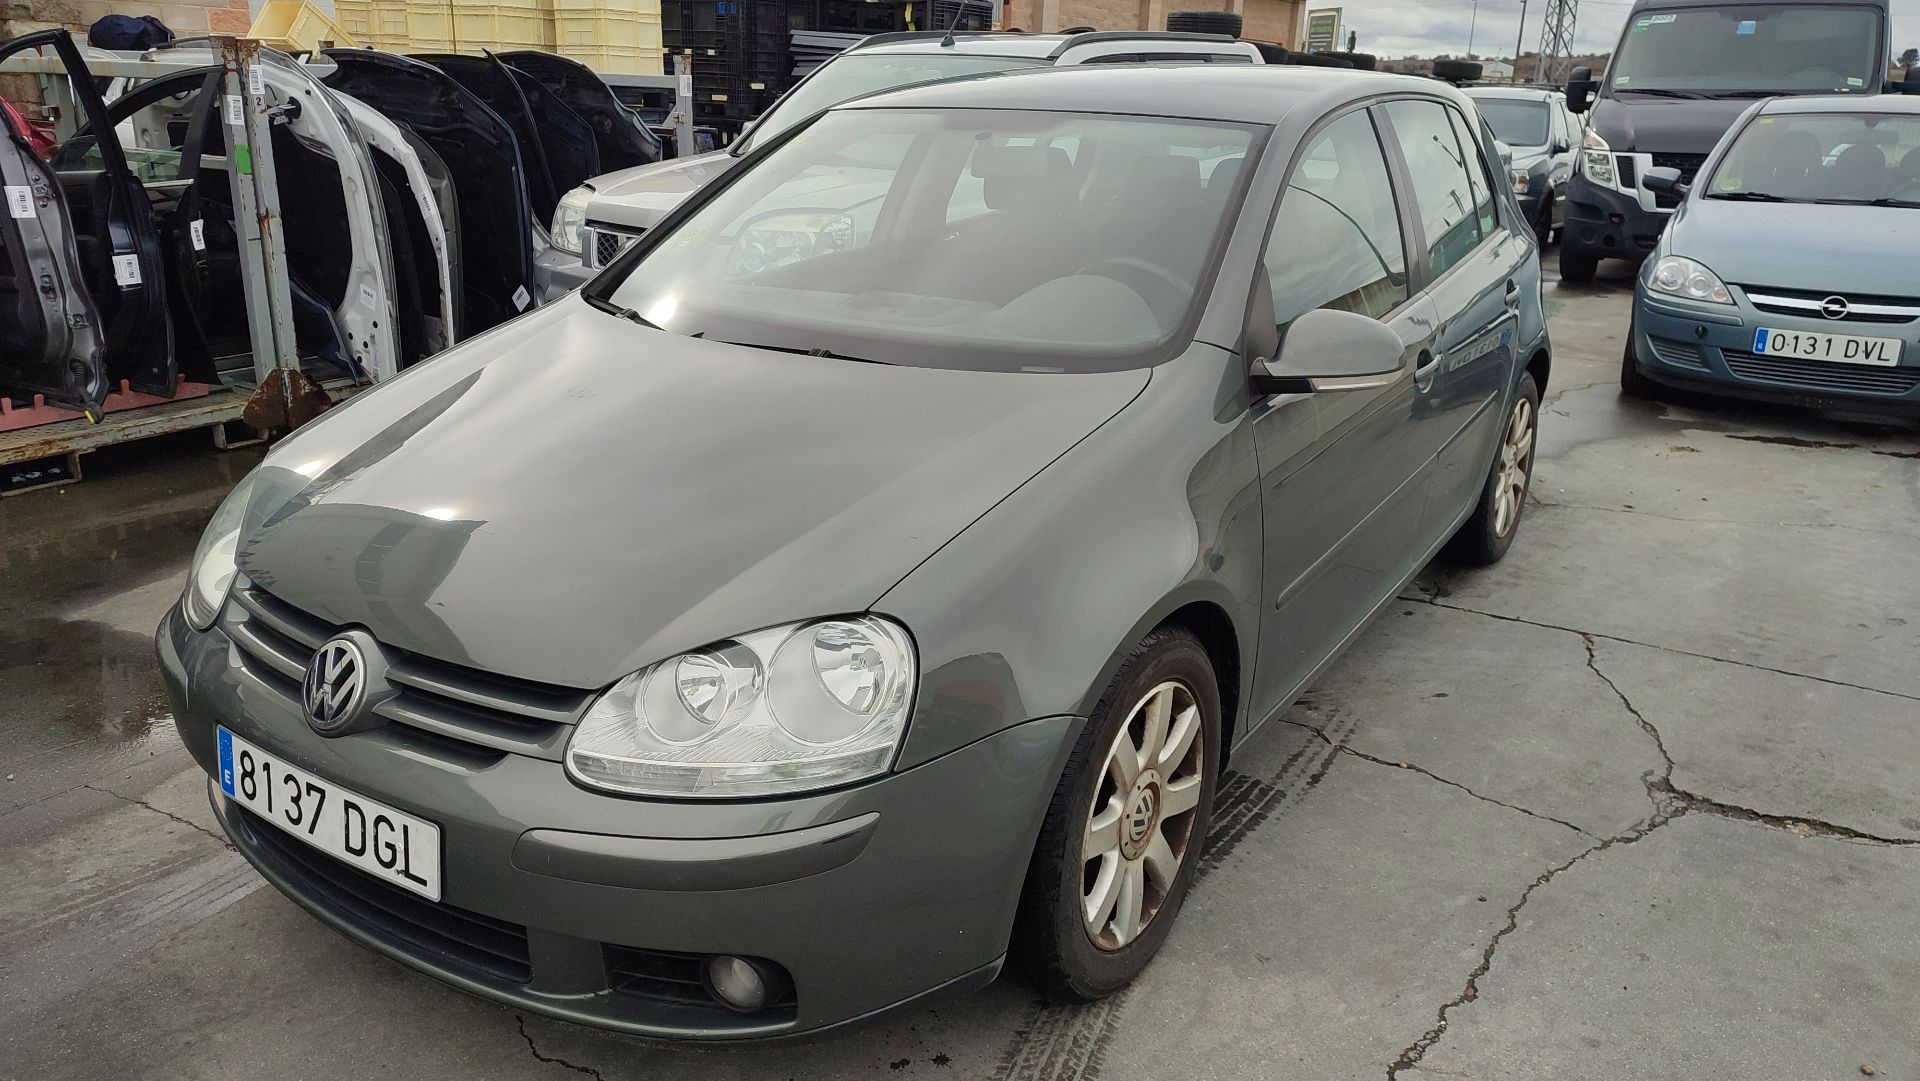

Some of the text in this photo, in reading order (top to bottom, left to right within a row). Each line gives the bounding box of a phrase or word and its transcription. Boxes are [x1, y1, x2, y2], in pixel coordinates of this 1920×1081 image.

[1772, 333, 1890, 362] 0131 DVL
[224, 769, 231, 784] E
[239, 750, 428, 887] 8137 DGL
